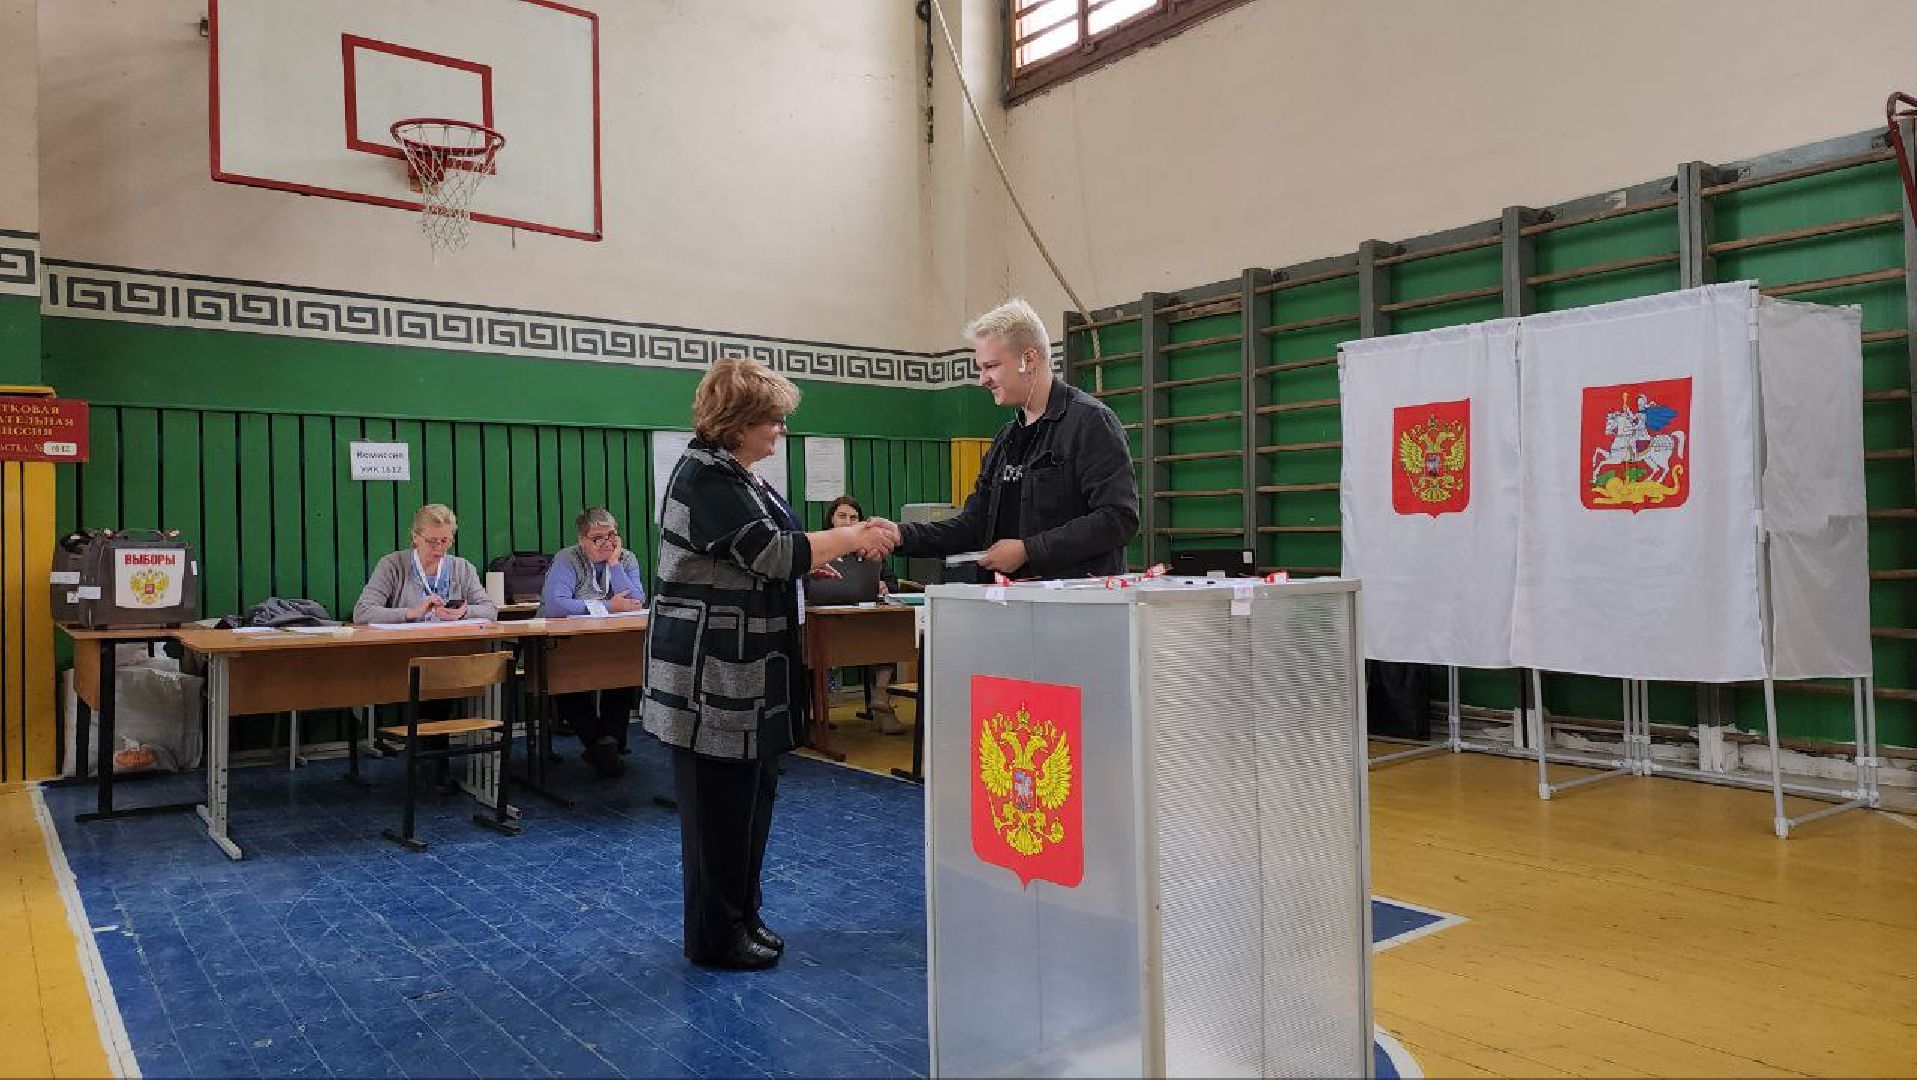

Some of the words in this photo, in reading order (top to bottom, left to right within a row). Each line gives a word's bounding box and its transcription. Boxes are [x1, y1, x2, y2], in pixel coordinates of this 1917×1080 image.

[1, 404, 60, 414] ТКОВАЯ
[0, 415, 74, 426] АТЕЛЬНАЯ
[1, 427, 53, 436] ИССИЯ
[124, 554, 176, 565] ВЫБОРЫ
